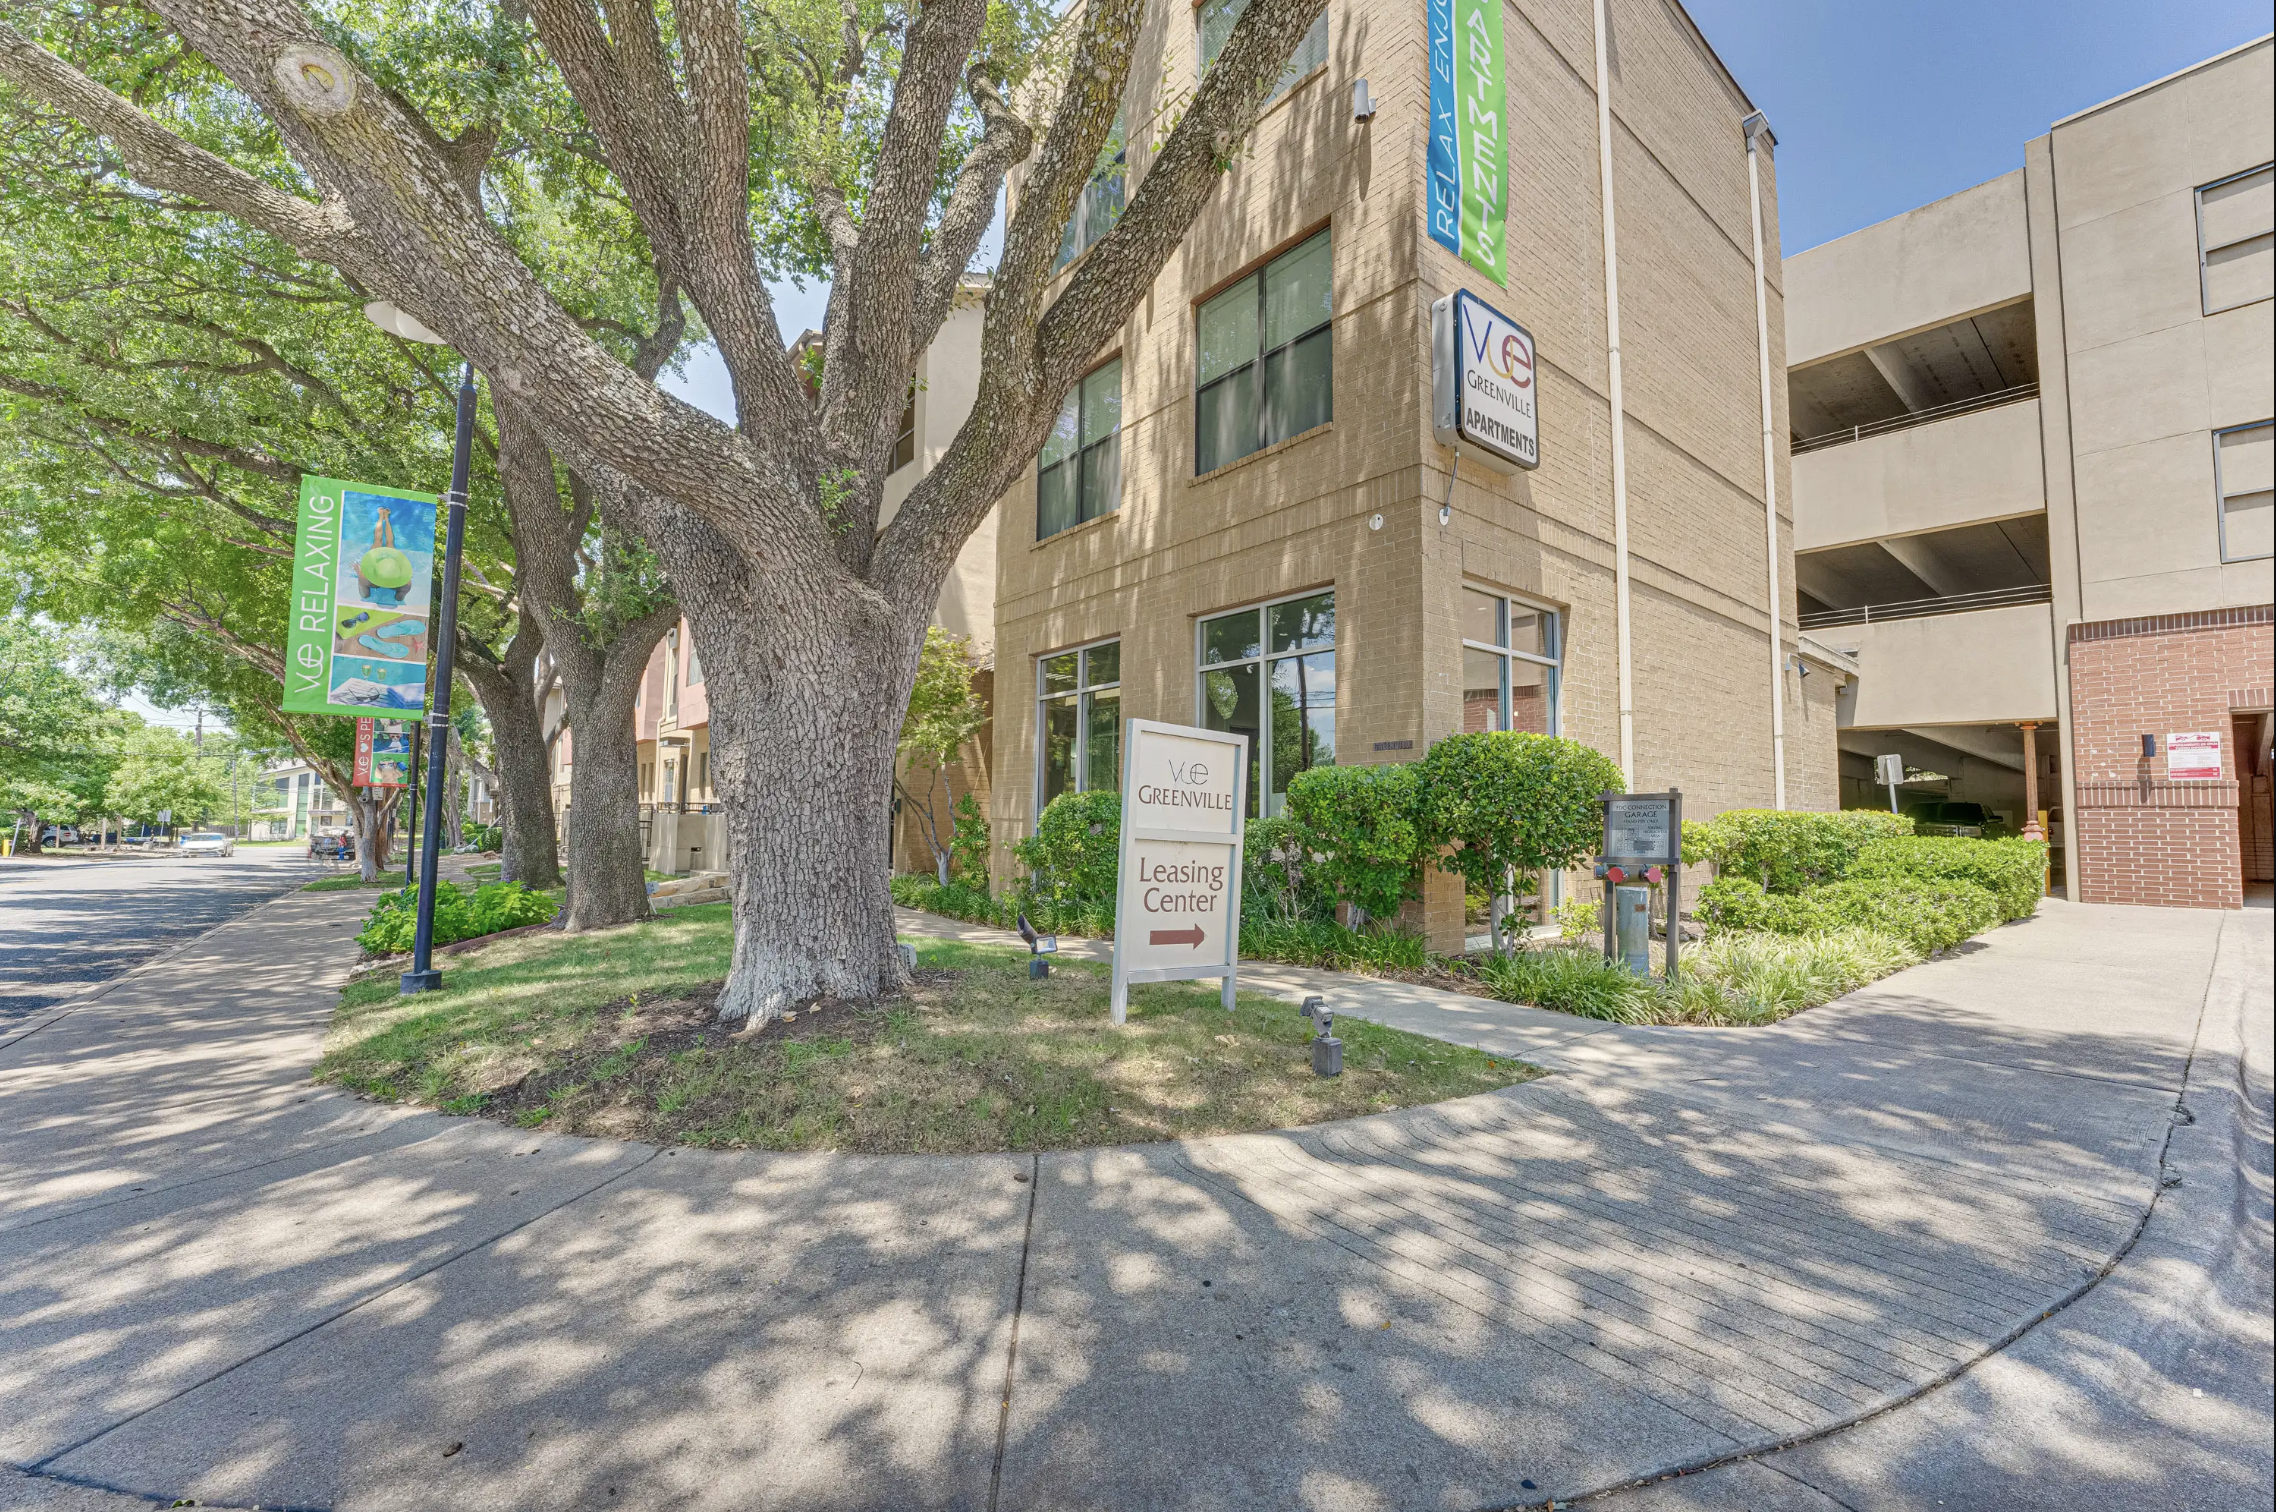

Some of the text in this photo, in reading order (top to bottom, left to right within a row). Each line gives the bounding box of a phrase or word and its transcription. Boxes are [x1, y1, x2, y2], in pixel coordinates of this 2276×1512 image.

[1467, 0, 1498, 267] ARTMENTS
[1436, 98, 1455, 240] RELAX
[1467, 369, 1532, 418] GREENVILLE
[1466, 407, 1535, 457] APARTMENTS
[299, 495, 335, 632] RELAXING
[1138, 785, 1232, 811] GREENVILLE
[1139, 857, 1224, 891] Leasing
[1143, 887, 1218, 913] Center
